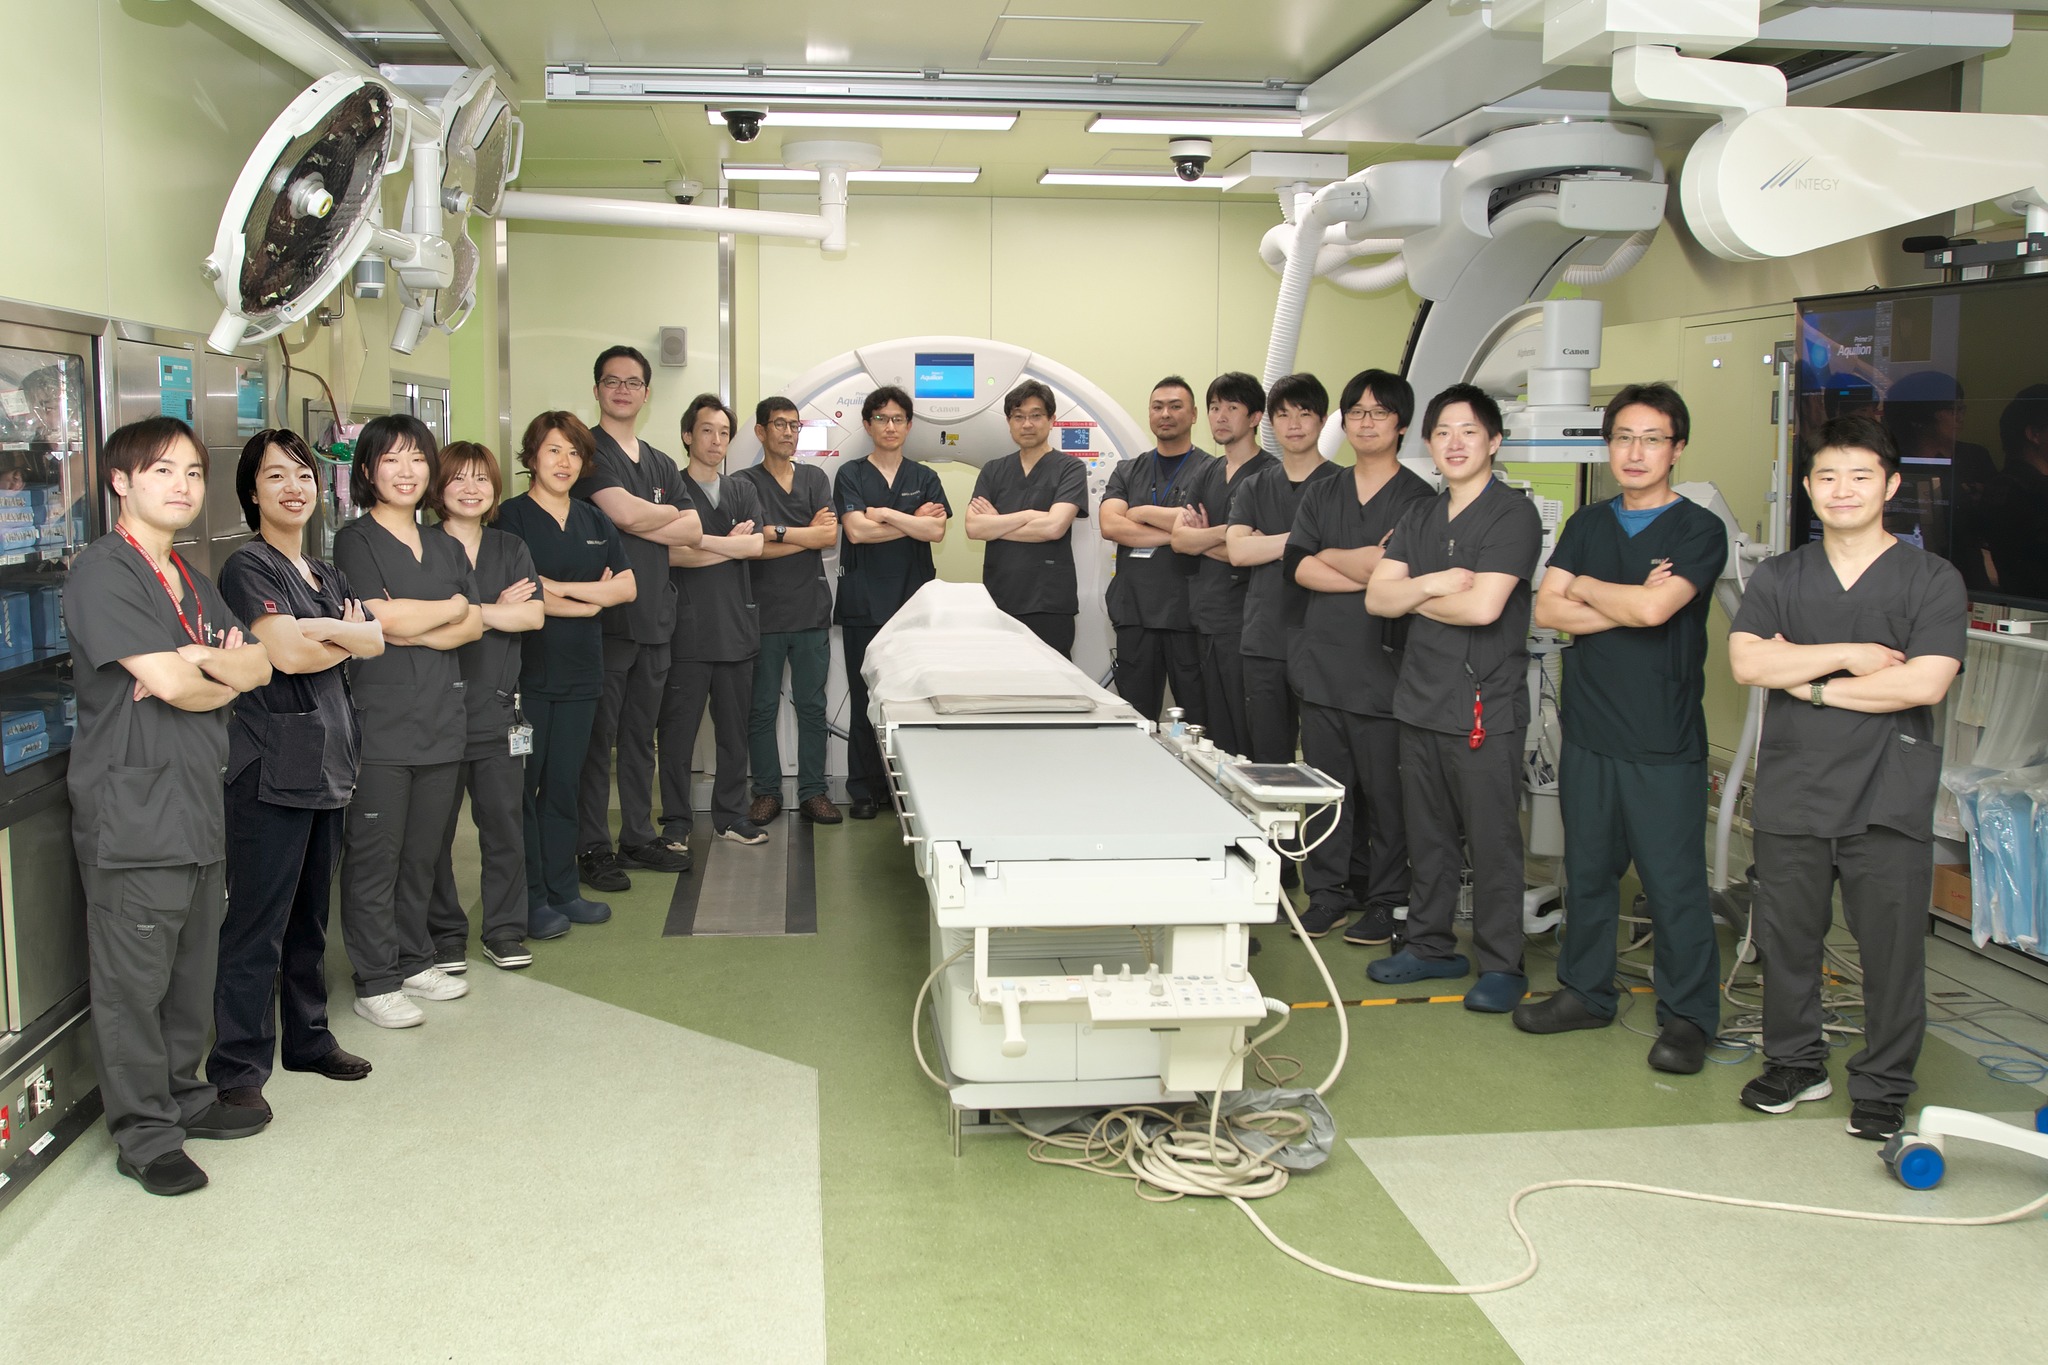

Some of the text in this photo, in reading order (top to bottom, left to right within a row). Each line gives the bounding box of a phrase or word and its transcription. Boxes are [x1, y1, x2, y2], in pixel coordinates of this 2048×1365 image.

[1795, 178, 1840, 191] INTEGY
[1562, 347, 1590, 355] Canon
[1837, 344, 1872, 358] Aquilion
[930, 405, 960, 413] Canon
